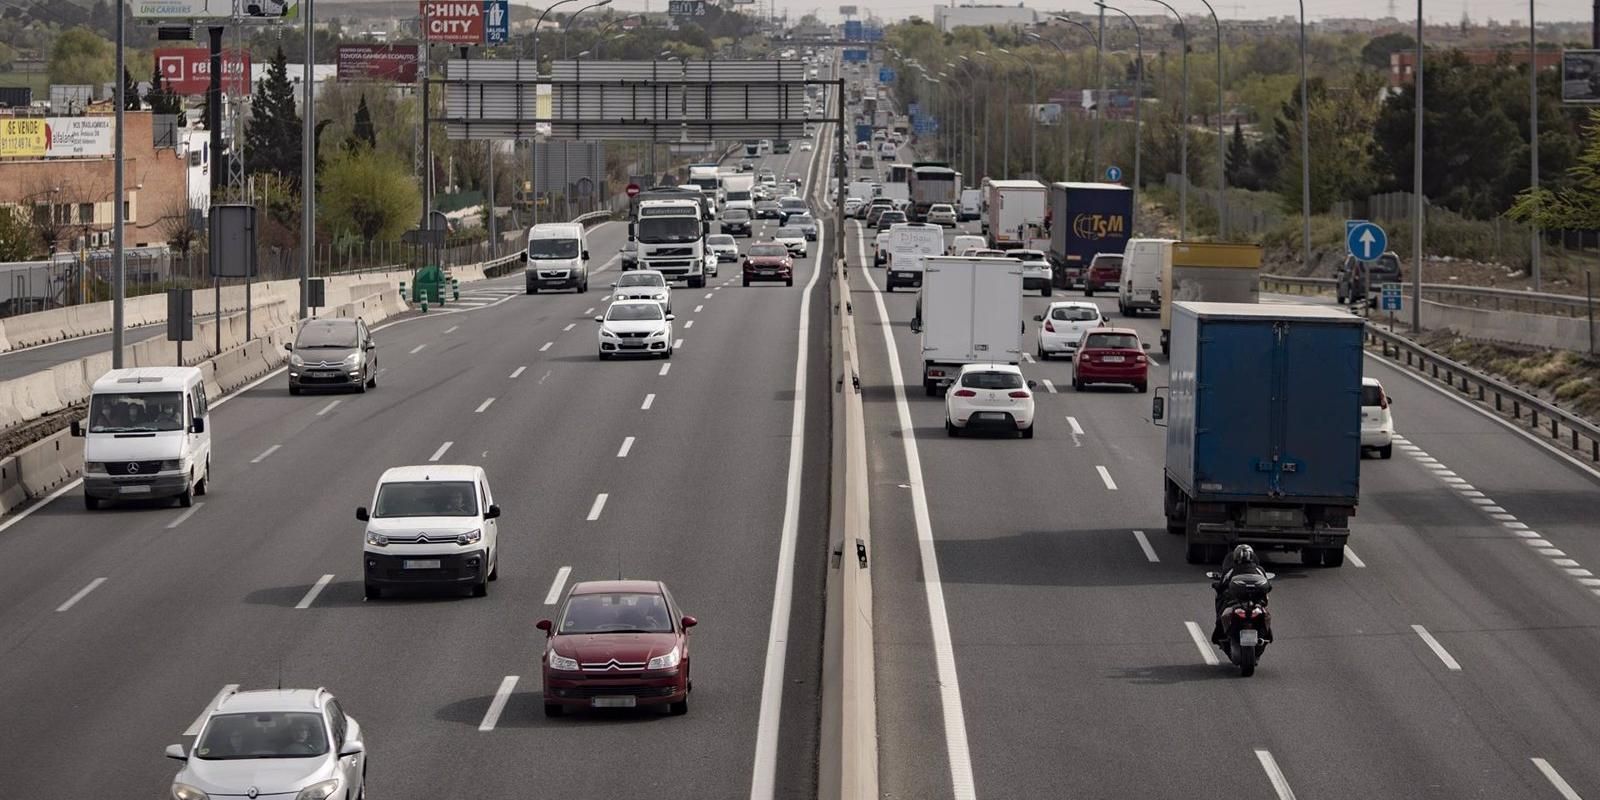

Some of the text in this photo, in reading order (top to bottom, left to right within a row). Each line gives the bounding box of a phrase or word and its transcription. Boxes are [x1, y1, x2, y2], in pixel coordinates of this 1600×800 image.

[424, 3, 480, 16] CHINA
[430, 20, 472, 33] CITY
[8, 121, 39, 134] SE VENDE
